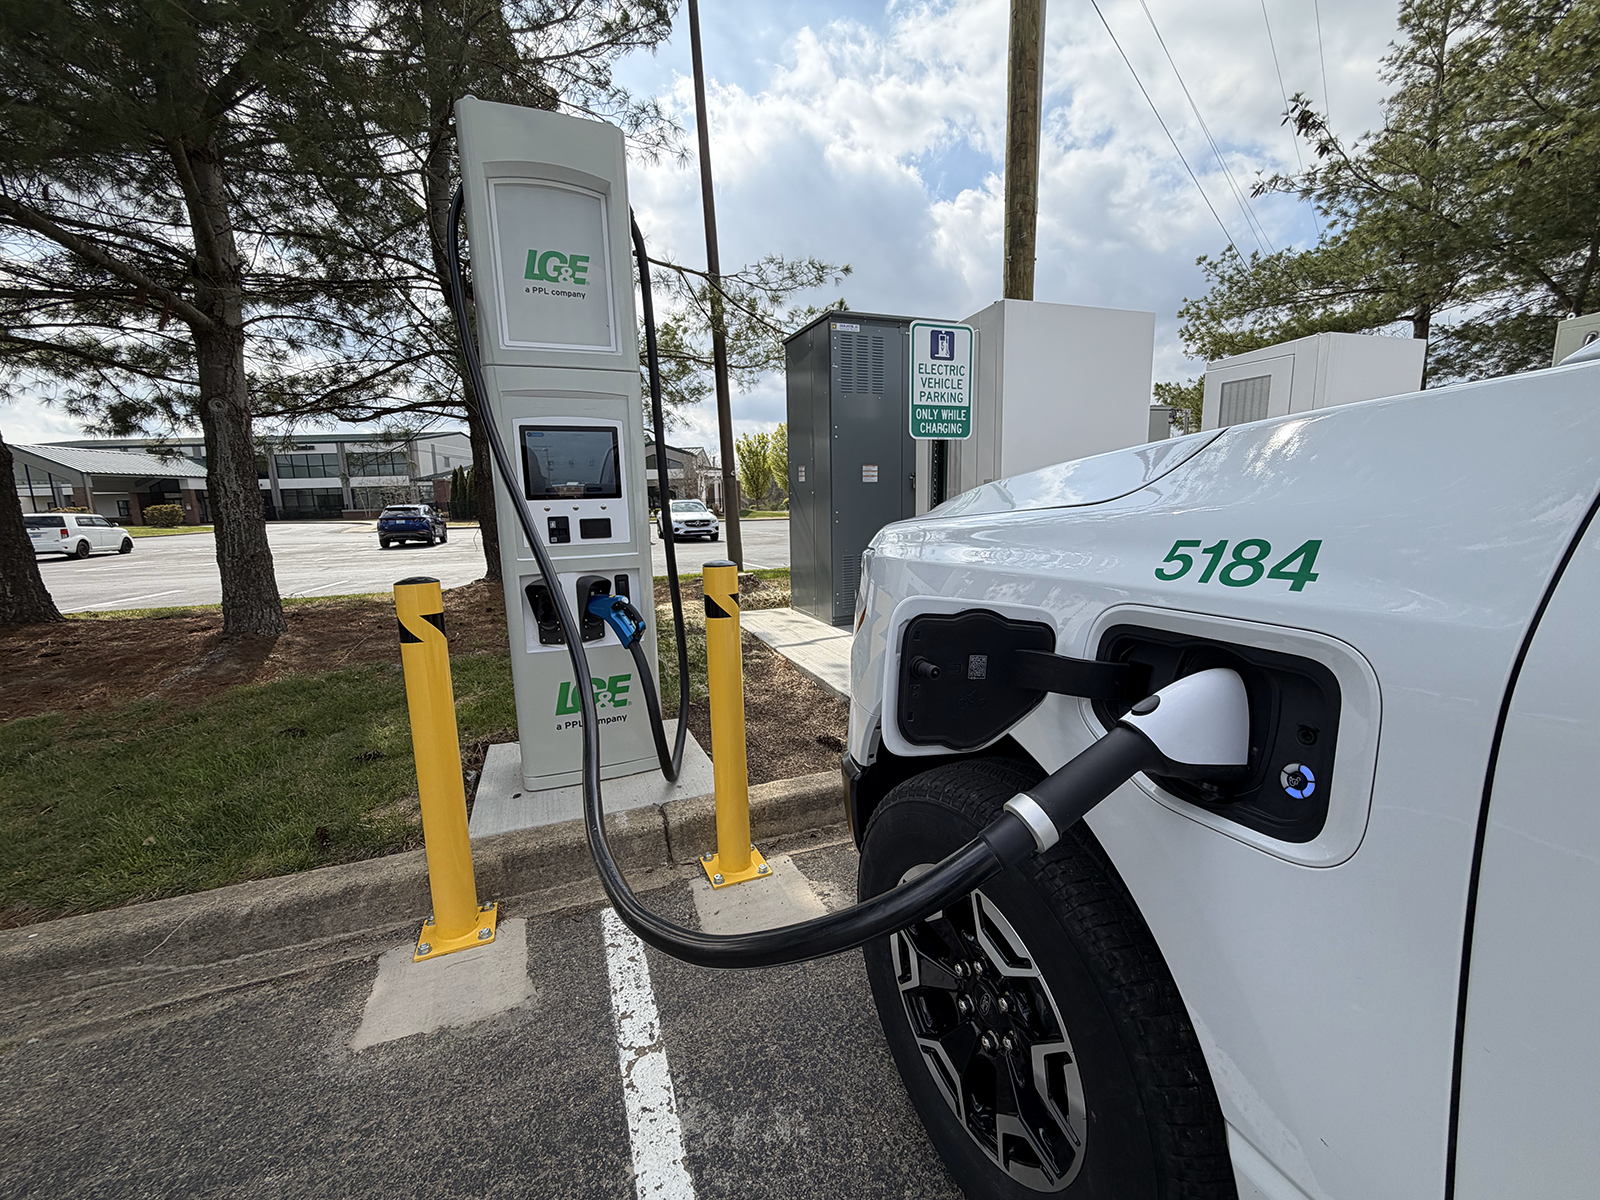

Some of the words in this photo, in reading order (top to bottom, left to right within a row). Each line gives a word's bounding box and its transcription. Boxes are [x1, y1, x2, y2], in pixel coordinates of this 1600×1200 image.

[524, 249, 590, 286] LG&E
[532, 286, 549, 295] PPL
[551, 289, 586, 299] company
[918, 363, 966, 377] ELECTRIC
[920, 377, 963, 390] VEHICLE
[919, 391, 964, 403] PARKING
[915, 408, 939, 420] ONLY
[941, 409, 967, 421] WHILE
[919, 422, 963, 434] CHARGING
[1154, 538, 1323, 592] 5184
[565, 720, 584, 729] PPL
[597, 714, 628, 726] mpany
